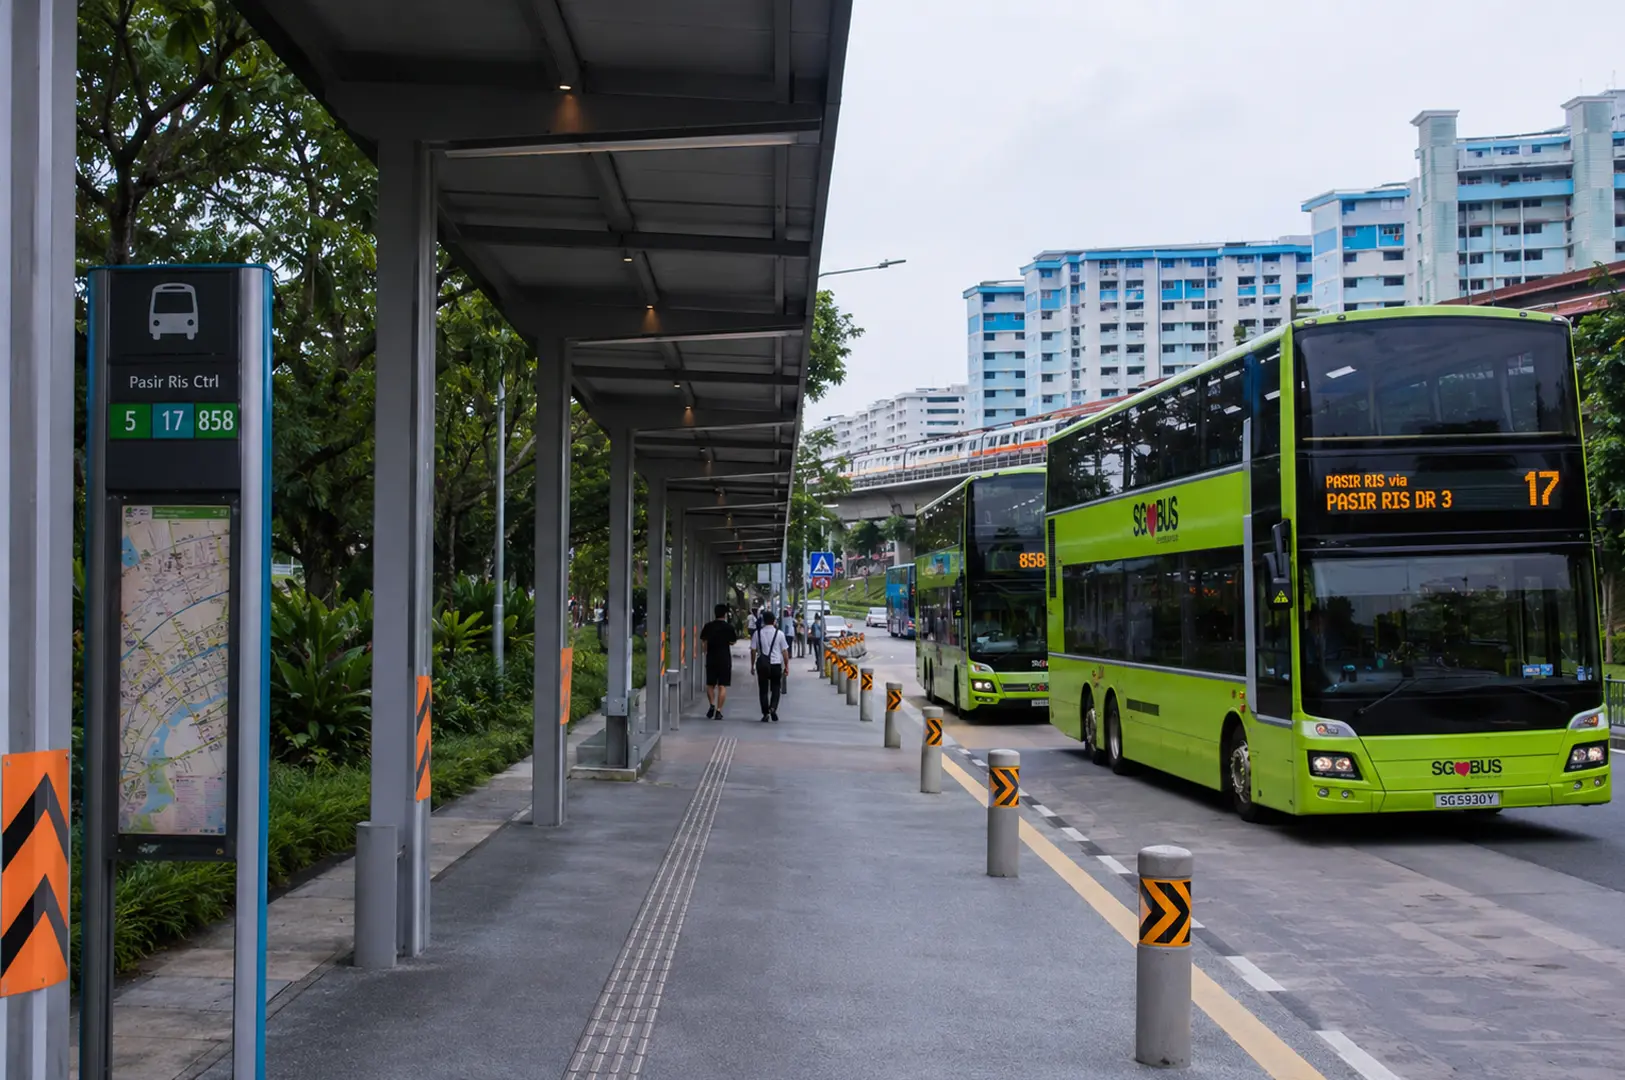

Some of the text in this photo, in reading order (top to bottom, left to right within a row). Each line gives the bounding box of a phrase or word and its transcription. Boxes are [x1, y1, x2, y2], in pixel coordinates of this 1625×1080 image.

[129, 374, 219, 389] Pasir Ris Ctrl
[125, 410, 234, 431] 5 17 858
[1325, 473, 1408, 489] PASIR RIS via
[1524, 470, 1560, 507] 17
[1326, 490, 1453, 511] PASIR RIS DR 3
[1019, 552, 1046, 569] 858
